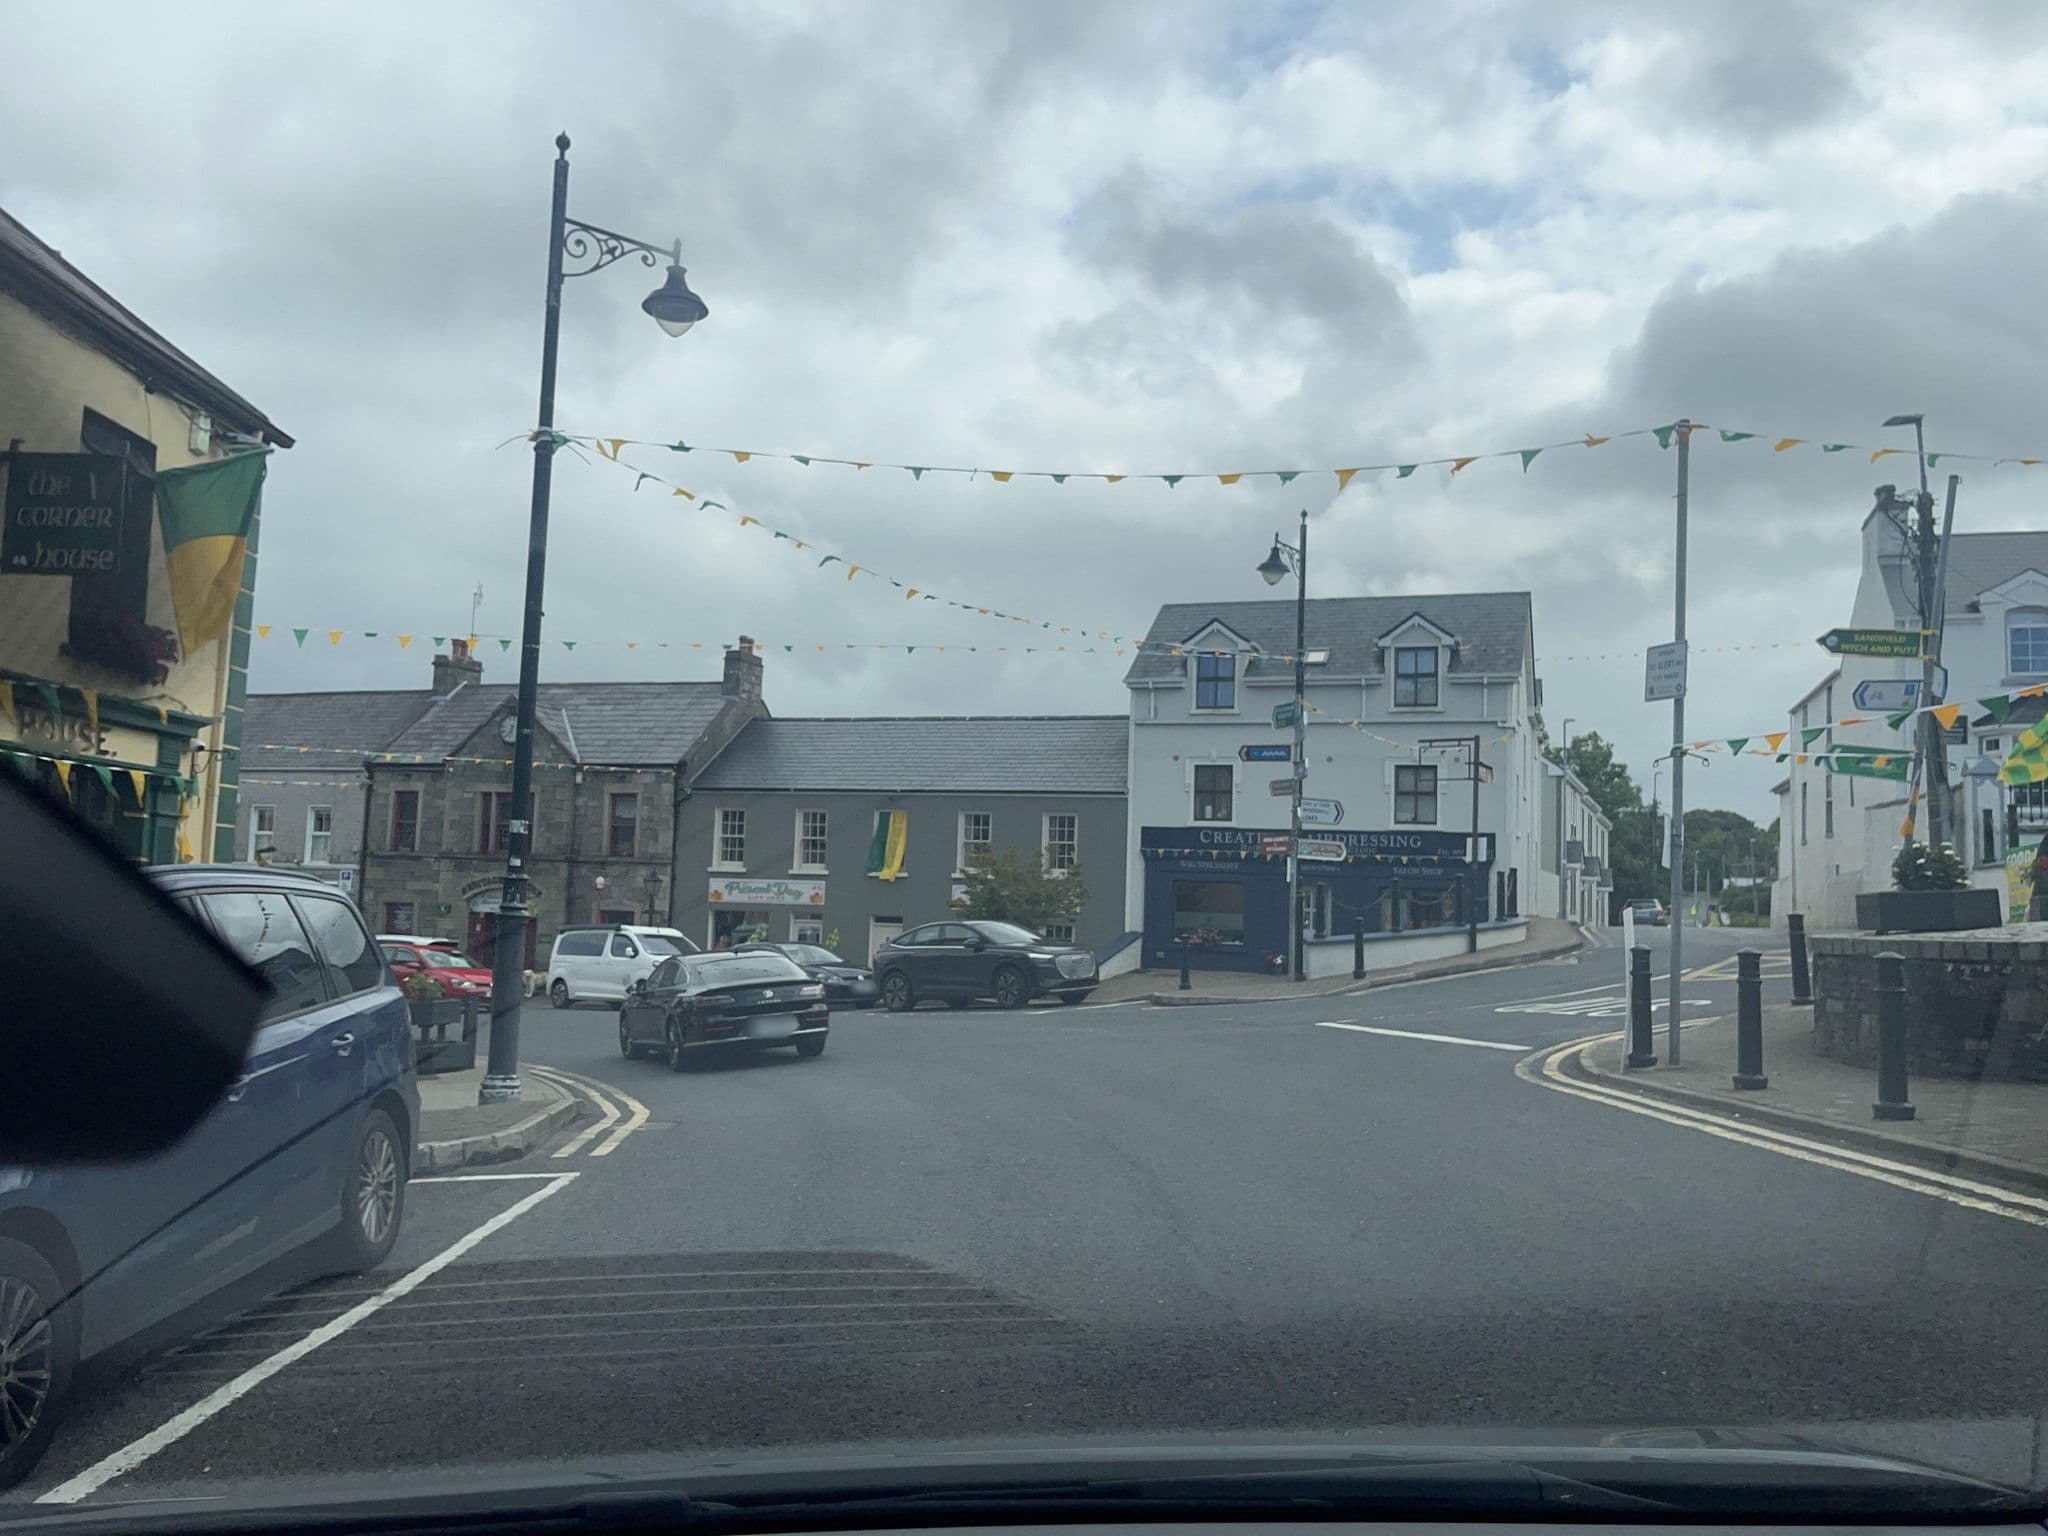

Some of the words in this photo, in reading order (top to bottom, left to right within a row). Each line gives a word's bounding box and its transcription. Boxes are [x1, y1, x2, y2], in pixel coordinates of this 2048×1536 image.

[33, 540, 114, 570] house
[1840, 643, 1867, 652] PITCH
[1871, 645, 1890, 654] AND
[1893, 646, 1917, 655] PUTT
[1200, 829, 1261, 844] CREATI
